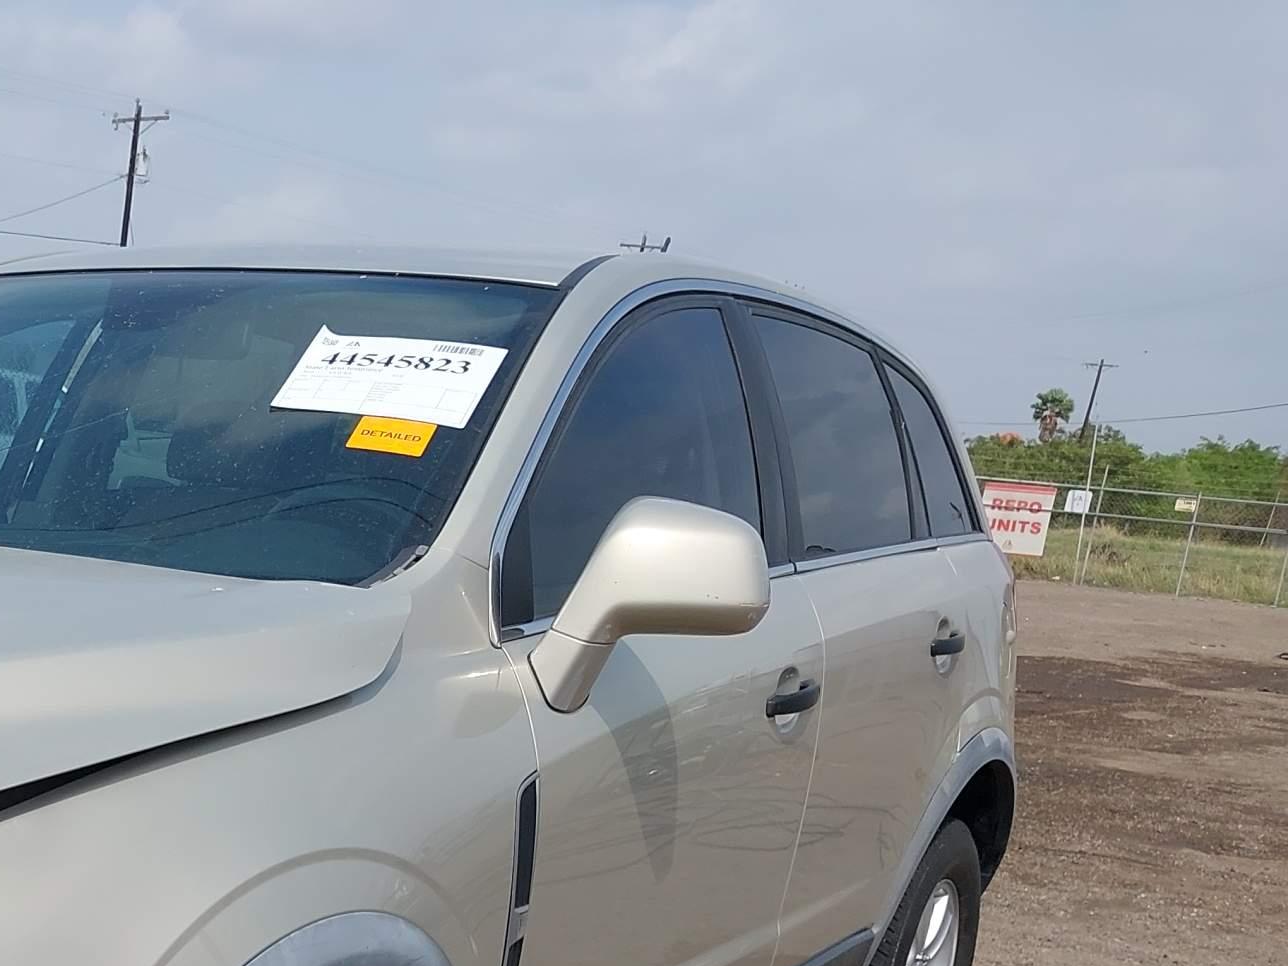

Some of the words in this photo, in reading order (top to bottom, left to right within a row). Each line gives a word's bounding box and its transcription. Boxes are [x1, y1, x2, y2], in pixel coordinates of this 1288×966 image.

[321, 352, 472, 375] 44545823
[360, 429, 422, 443] DETAILED
[991, 498, 1042, 514] REPO
